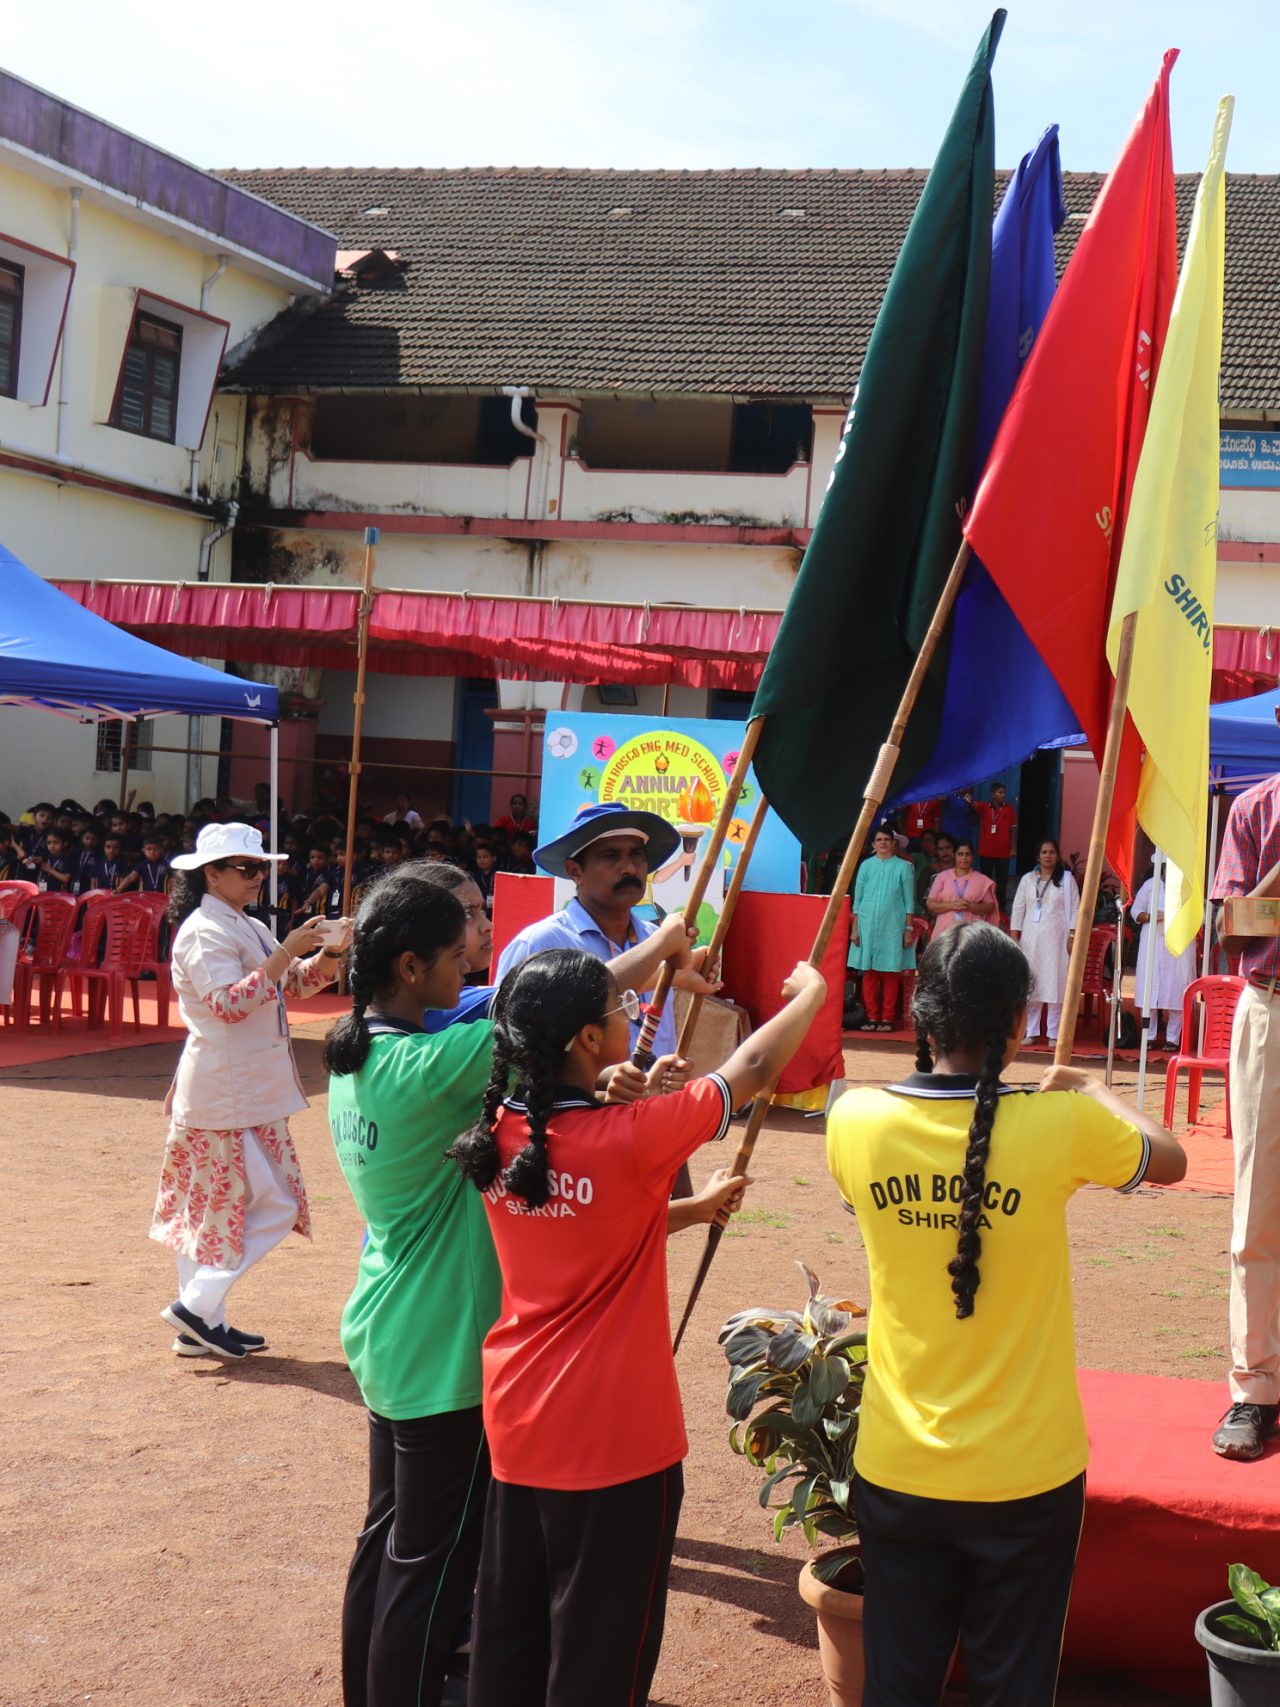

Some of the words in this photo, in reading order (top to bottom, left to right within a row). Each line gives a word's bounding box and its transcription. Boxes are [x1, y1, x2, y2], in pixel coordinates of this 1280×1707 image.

[665, 740, 690, 758] MED
[547, 1169, 593, 1205] SCO
[869, 1174, 921, 1210] DON
[932, 1174, 1021, 1216] BOCO
[898, 1209, 992, 1230] SHIRA
